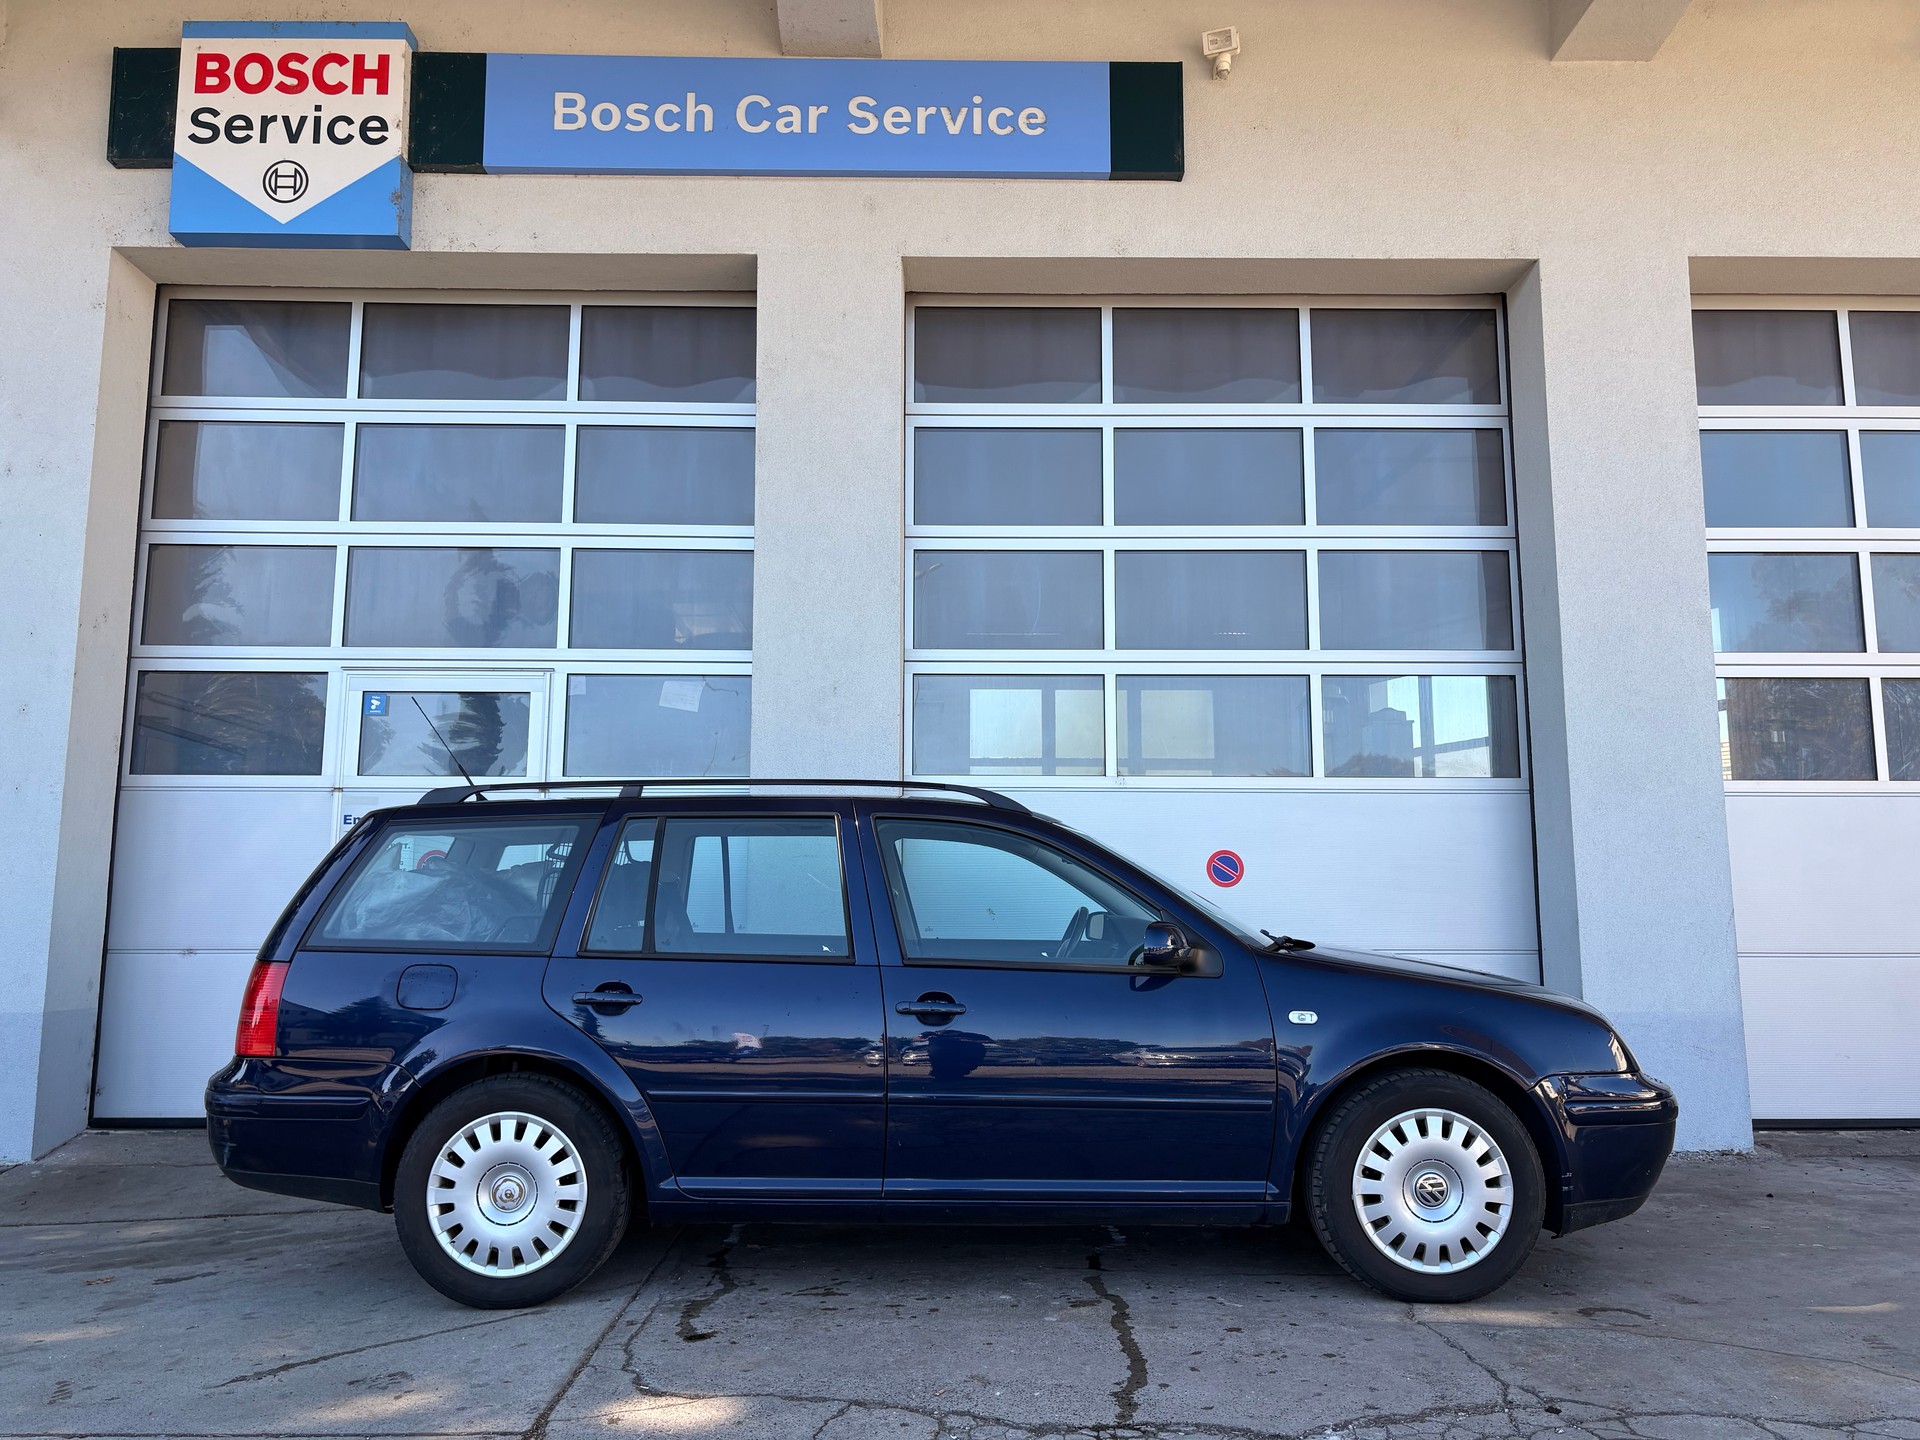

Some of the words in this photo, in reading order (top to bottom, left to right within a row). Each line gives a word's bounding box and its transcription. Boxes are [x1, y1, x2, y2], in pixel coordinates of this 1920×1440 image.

[194, 52, 390, 95] BOSCH
[187, 104, 389, 145] Service
[554, 92, 713, 132] Bosch
[736, 94, 829, 133] Car
[847, 95, 1046, 135] Service
